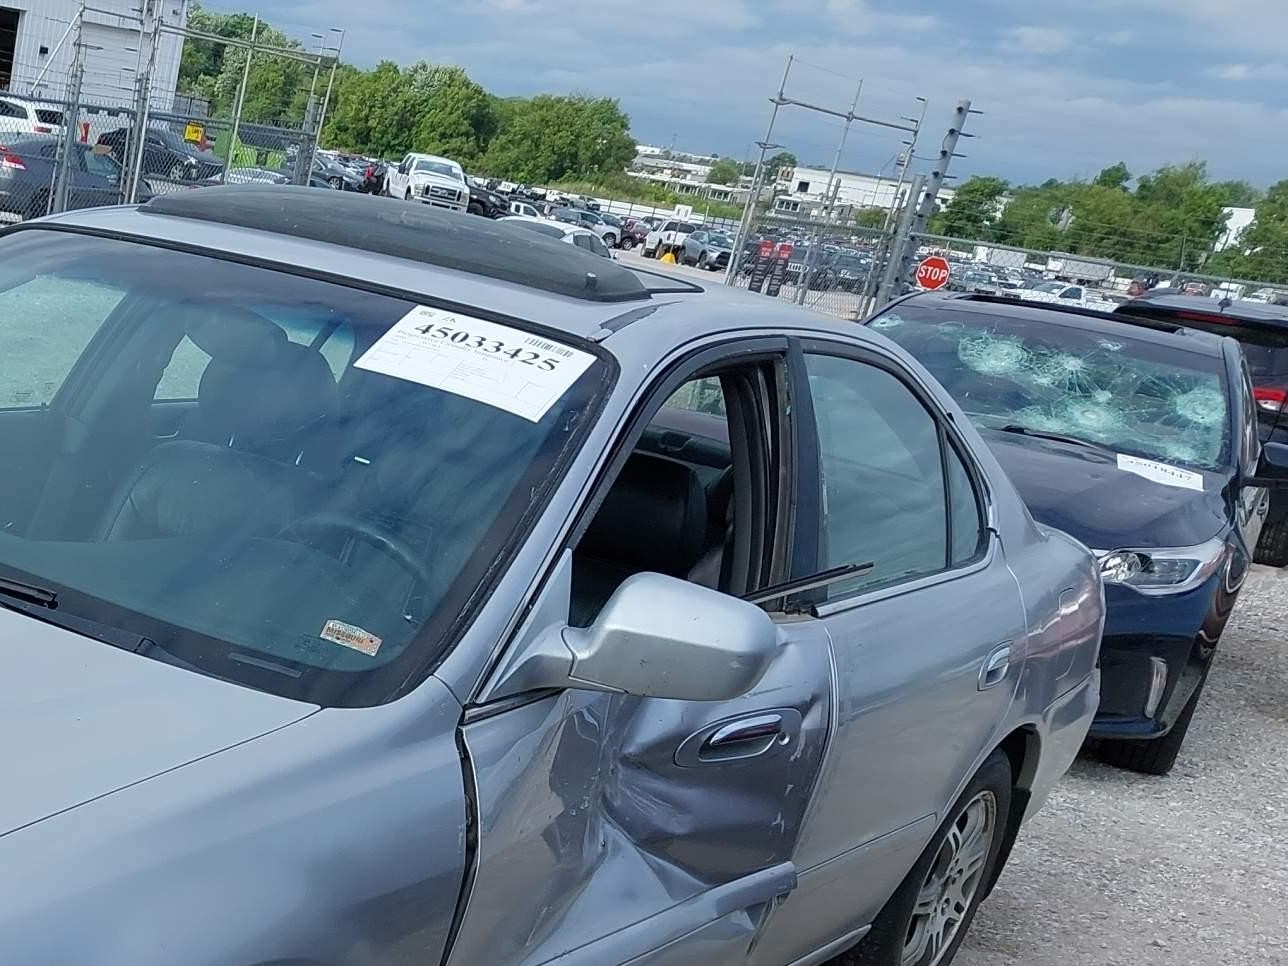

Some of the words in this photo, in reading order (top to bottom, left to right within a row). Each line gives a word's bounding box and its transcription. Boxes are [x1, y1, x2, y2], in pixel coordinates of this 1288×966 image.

[918, 264, 948, 281] STOP
[414, 323, 561, 373] 45033425
[325, 626, 365, 645] MISSOURI
